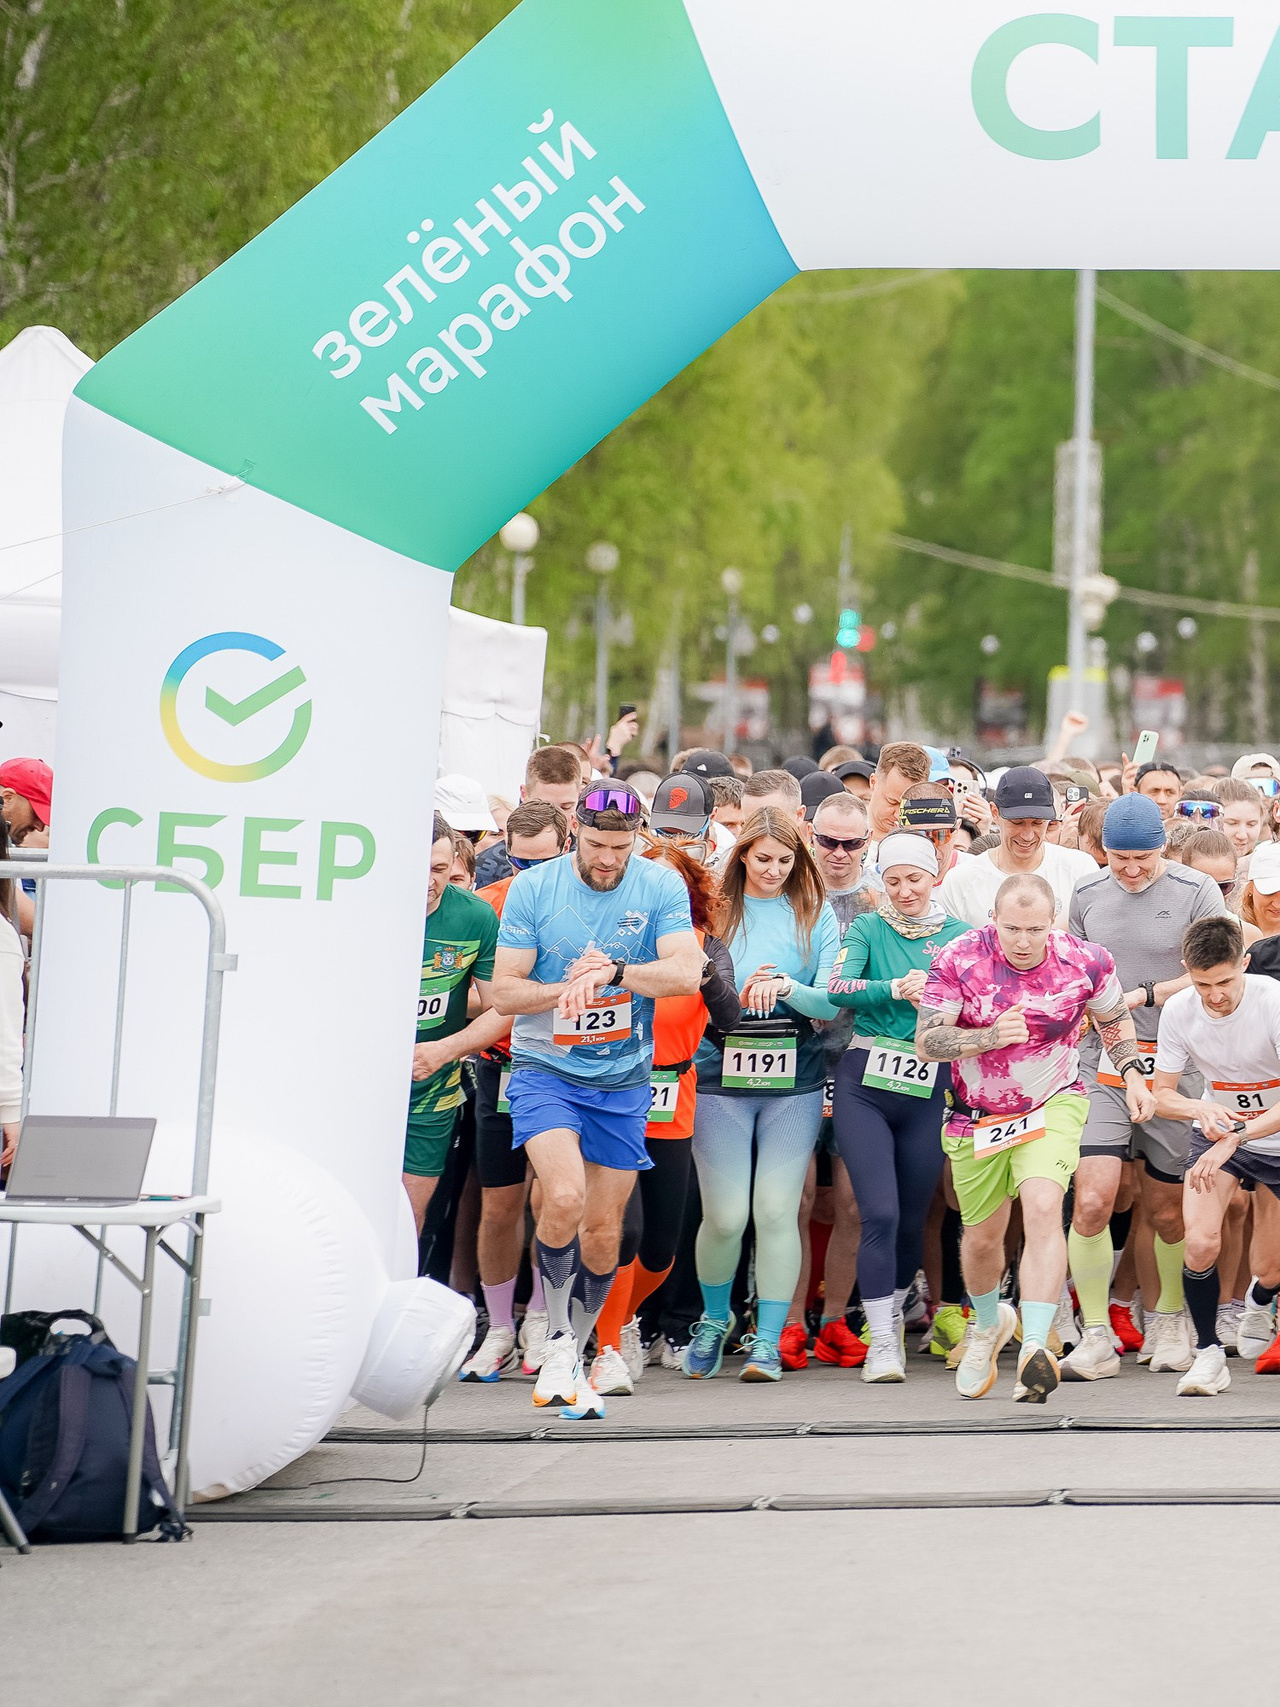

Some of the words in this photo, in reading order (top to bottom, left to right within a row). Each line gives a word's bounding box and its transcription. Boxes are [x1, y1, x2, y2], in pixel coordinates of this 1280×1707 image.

[312, 108, 598, 379] зелёный
[359, 175, 646, 435] марафон
[87, 807, 376, 901] СБЕР
[575, 1010, 616, 1031] 123
[732, 1052, 786, 1073] 1191
[877, 1052, 929, 1081] 1126
[1236, 1093, 1264, 1109] 81
[989, 1116, 1029, 1143] 241
